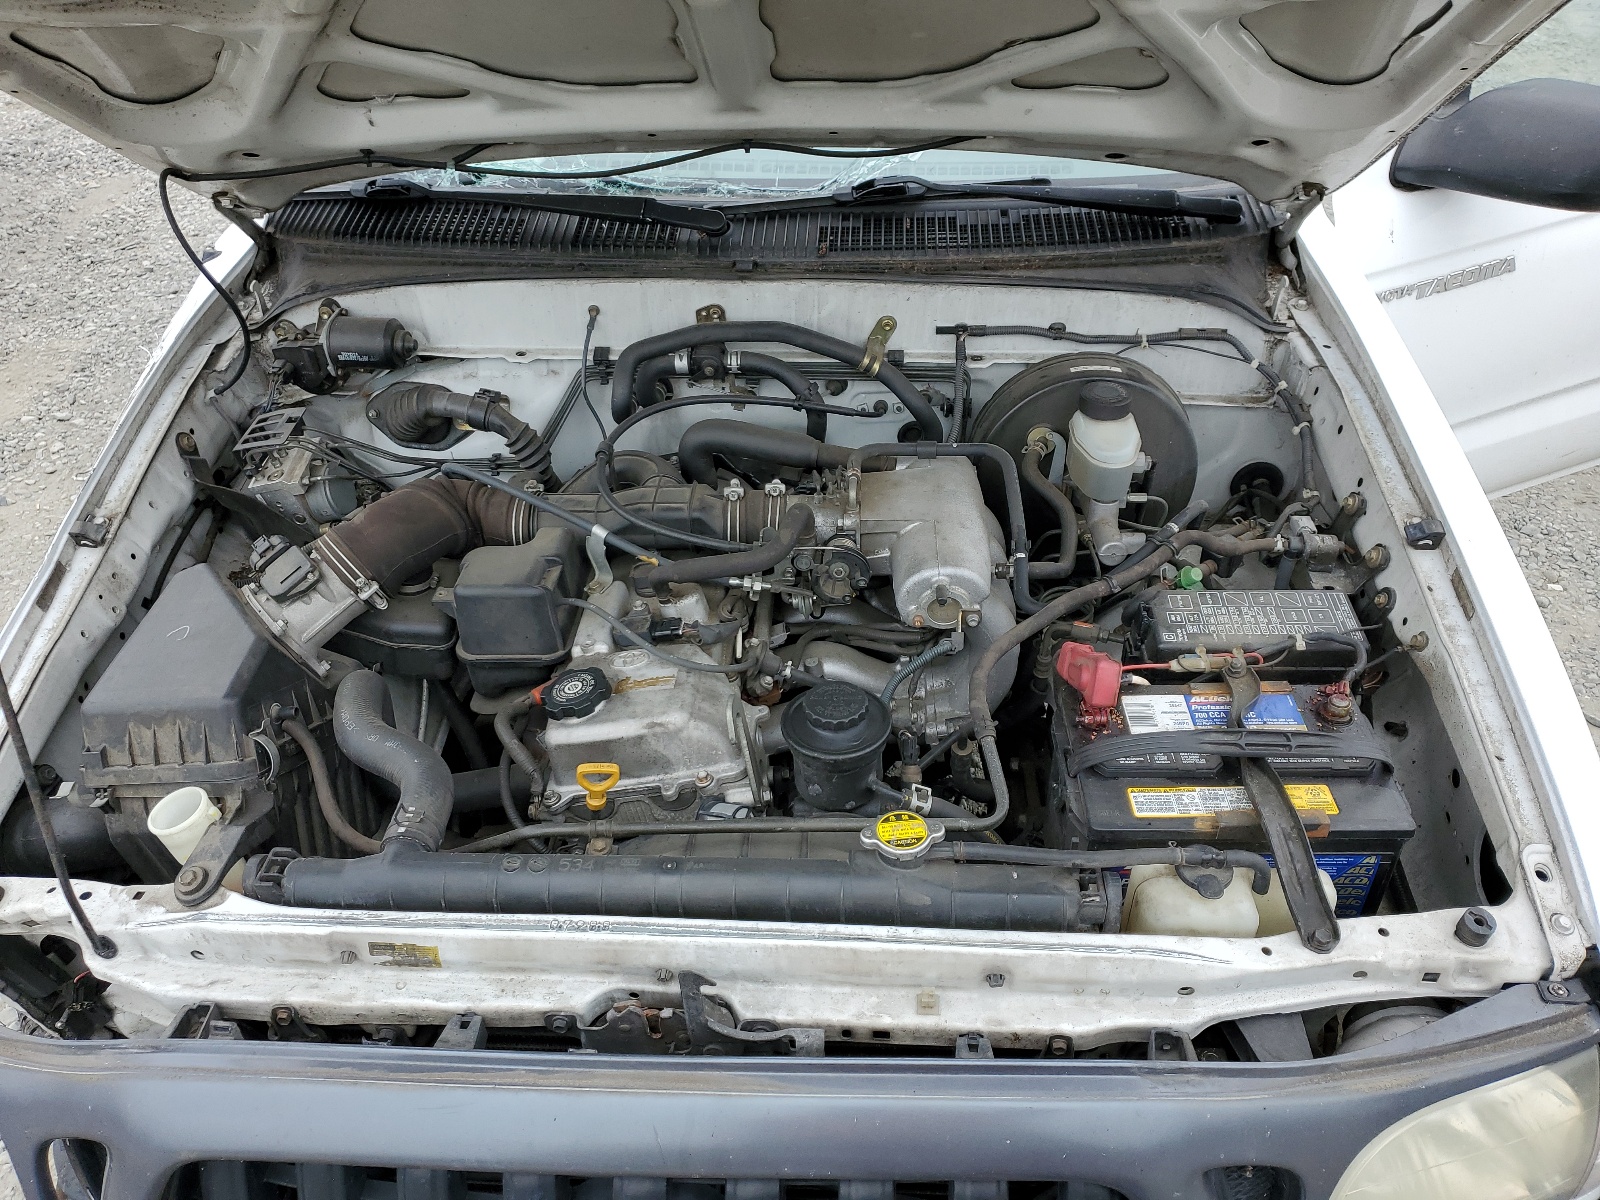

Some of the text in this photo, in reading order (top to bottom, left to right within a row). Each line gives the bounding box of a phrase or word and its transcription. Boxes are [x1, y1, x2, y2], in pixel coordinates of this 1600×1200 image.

[1376, 255, 1516, 303] YOTA TACOMA
[558, 858, 595, 871] 534
